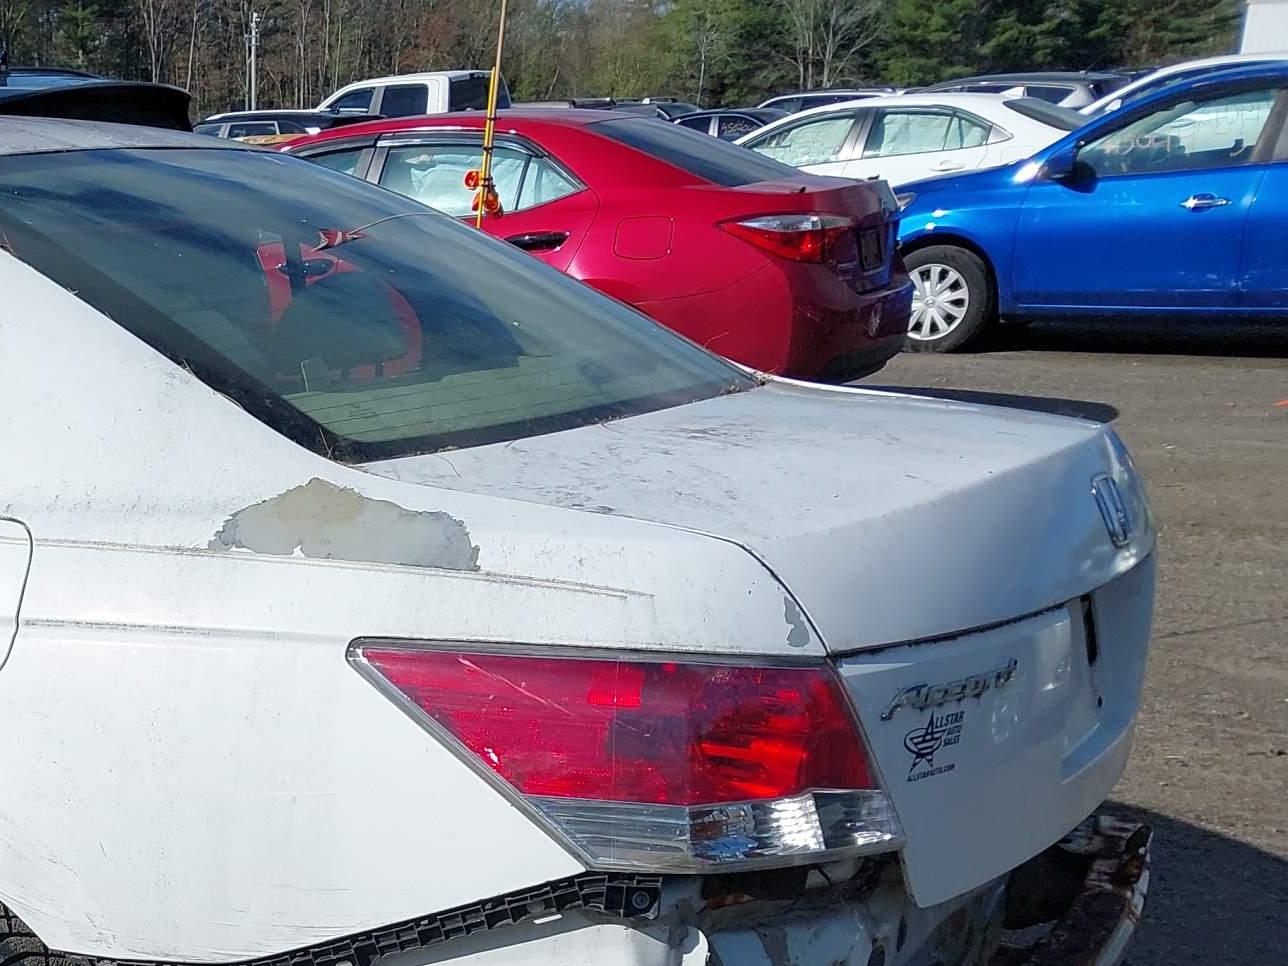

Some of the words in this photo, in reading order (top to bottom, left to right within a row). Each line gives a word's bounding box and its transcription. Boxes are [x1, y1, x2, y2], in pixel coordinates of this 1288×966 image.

[880, 658, 1018, 721] Accord
[946, 725, 962, 736] AUTO
[942, 735, 961, 748] SALES
